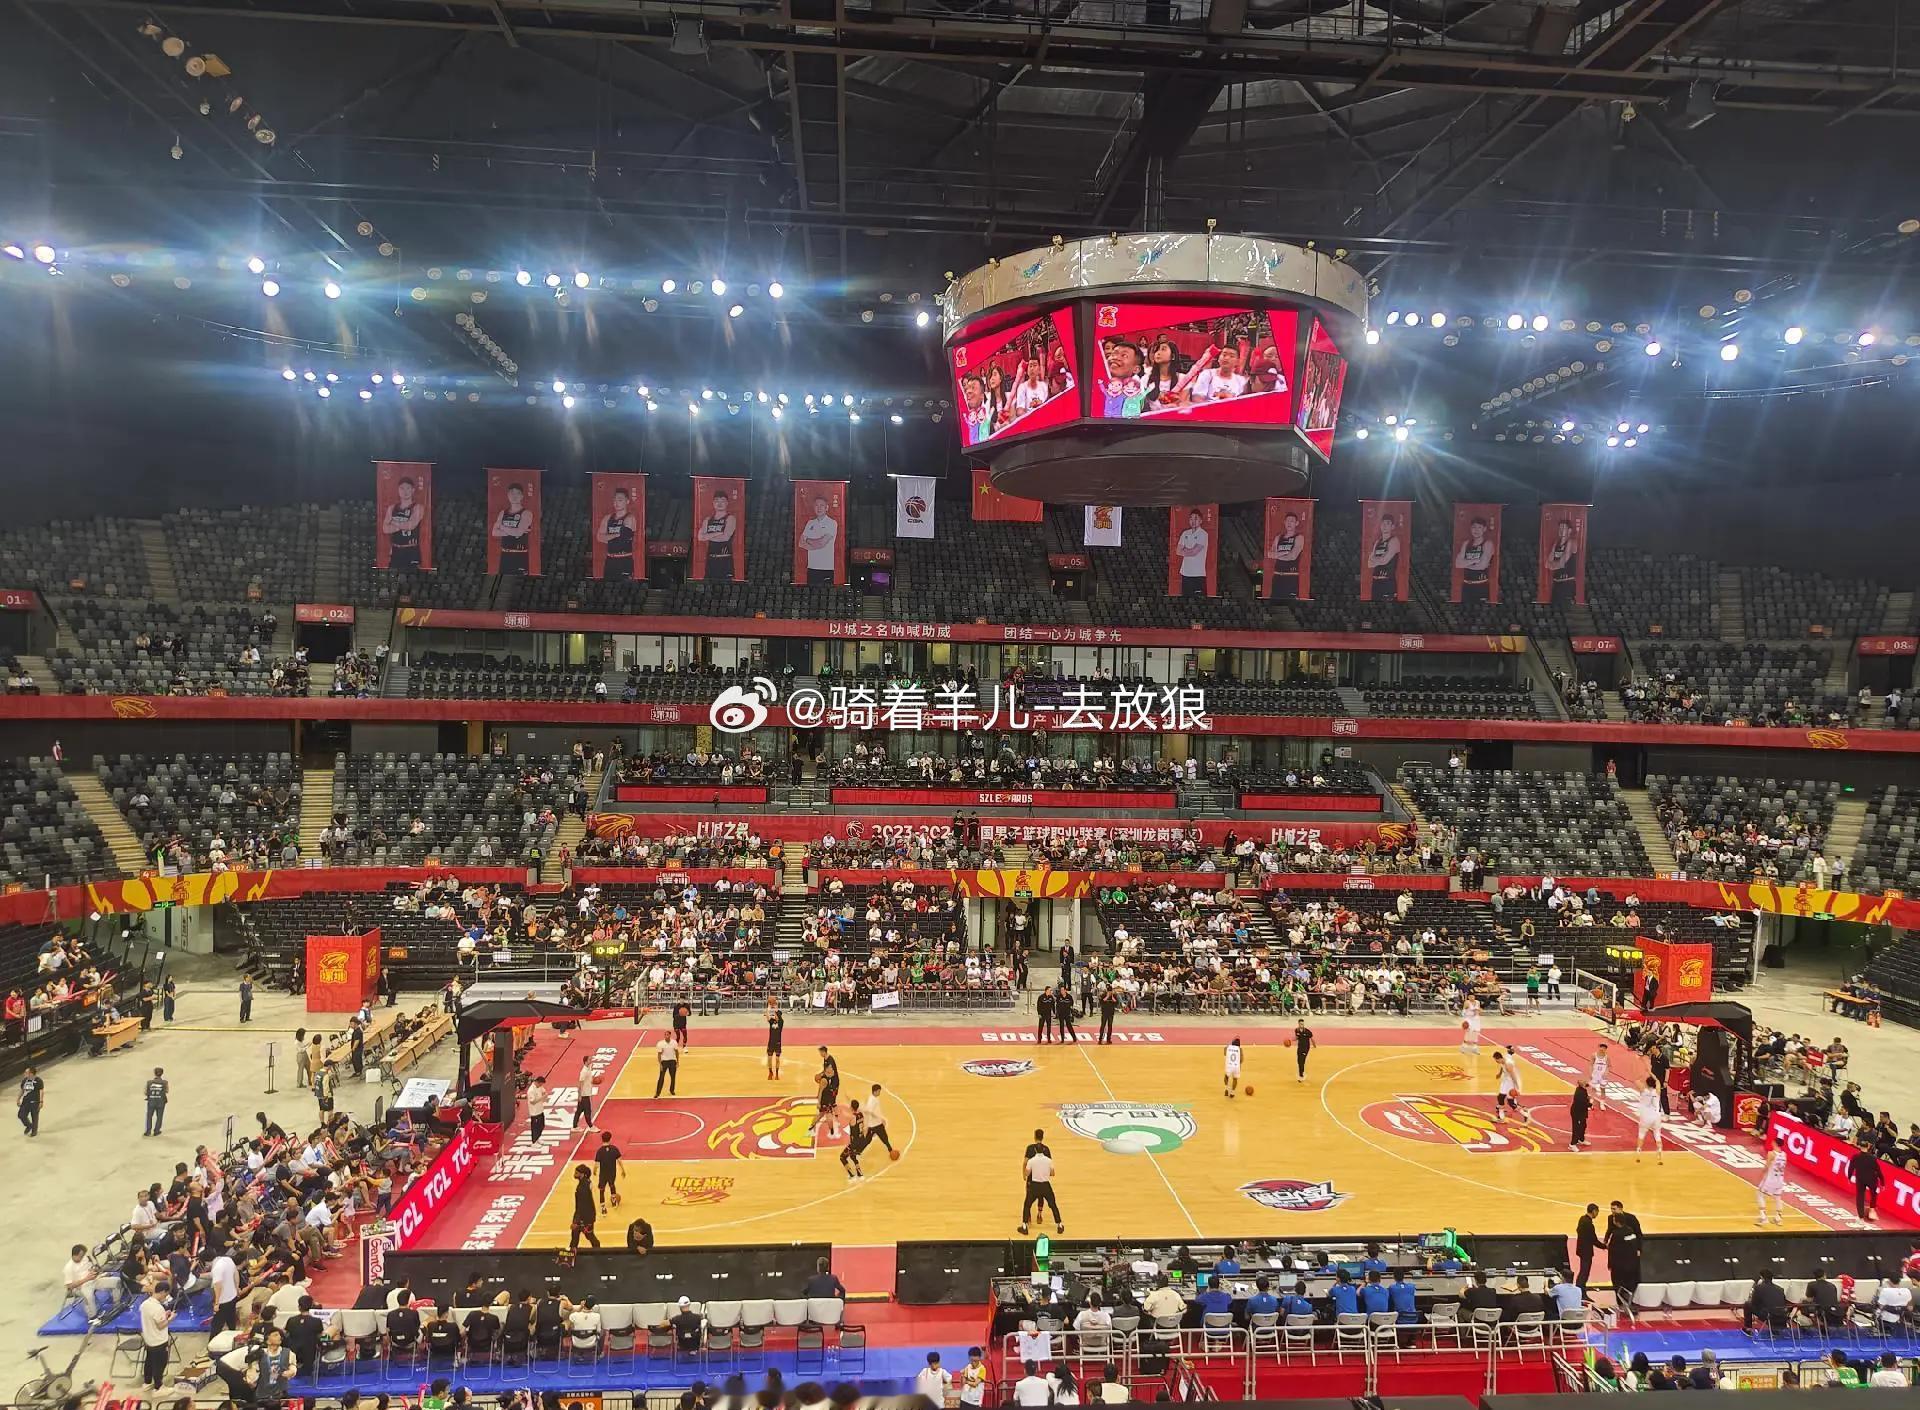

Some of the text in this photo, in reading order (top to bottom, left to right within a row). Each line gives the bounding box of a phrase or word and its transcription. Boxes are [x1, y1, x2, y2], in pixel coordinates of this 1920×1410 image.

[828, 623, 1122, 641] 以城之名呐喊助威 团结一心为城争先
[1773, 1123, 1818, 1164] TCL
[424, 1168, 452, 1208] TCL
[395, 1201, 423, 1248] TCL
